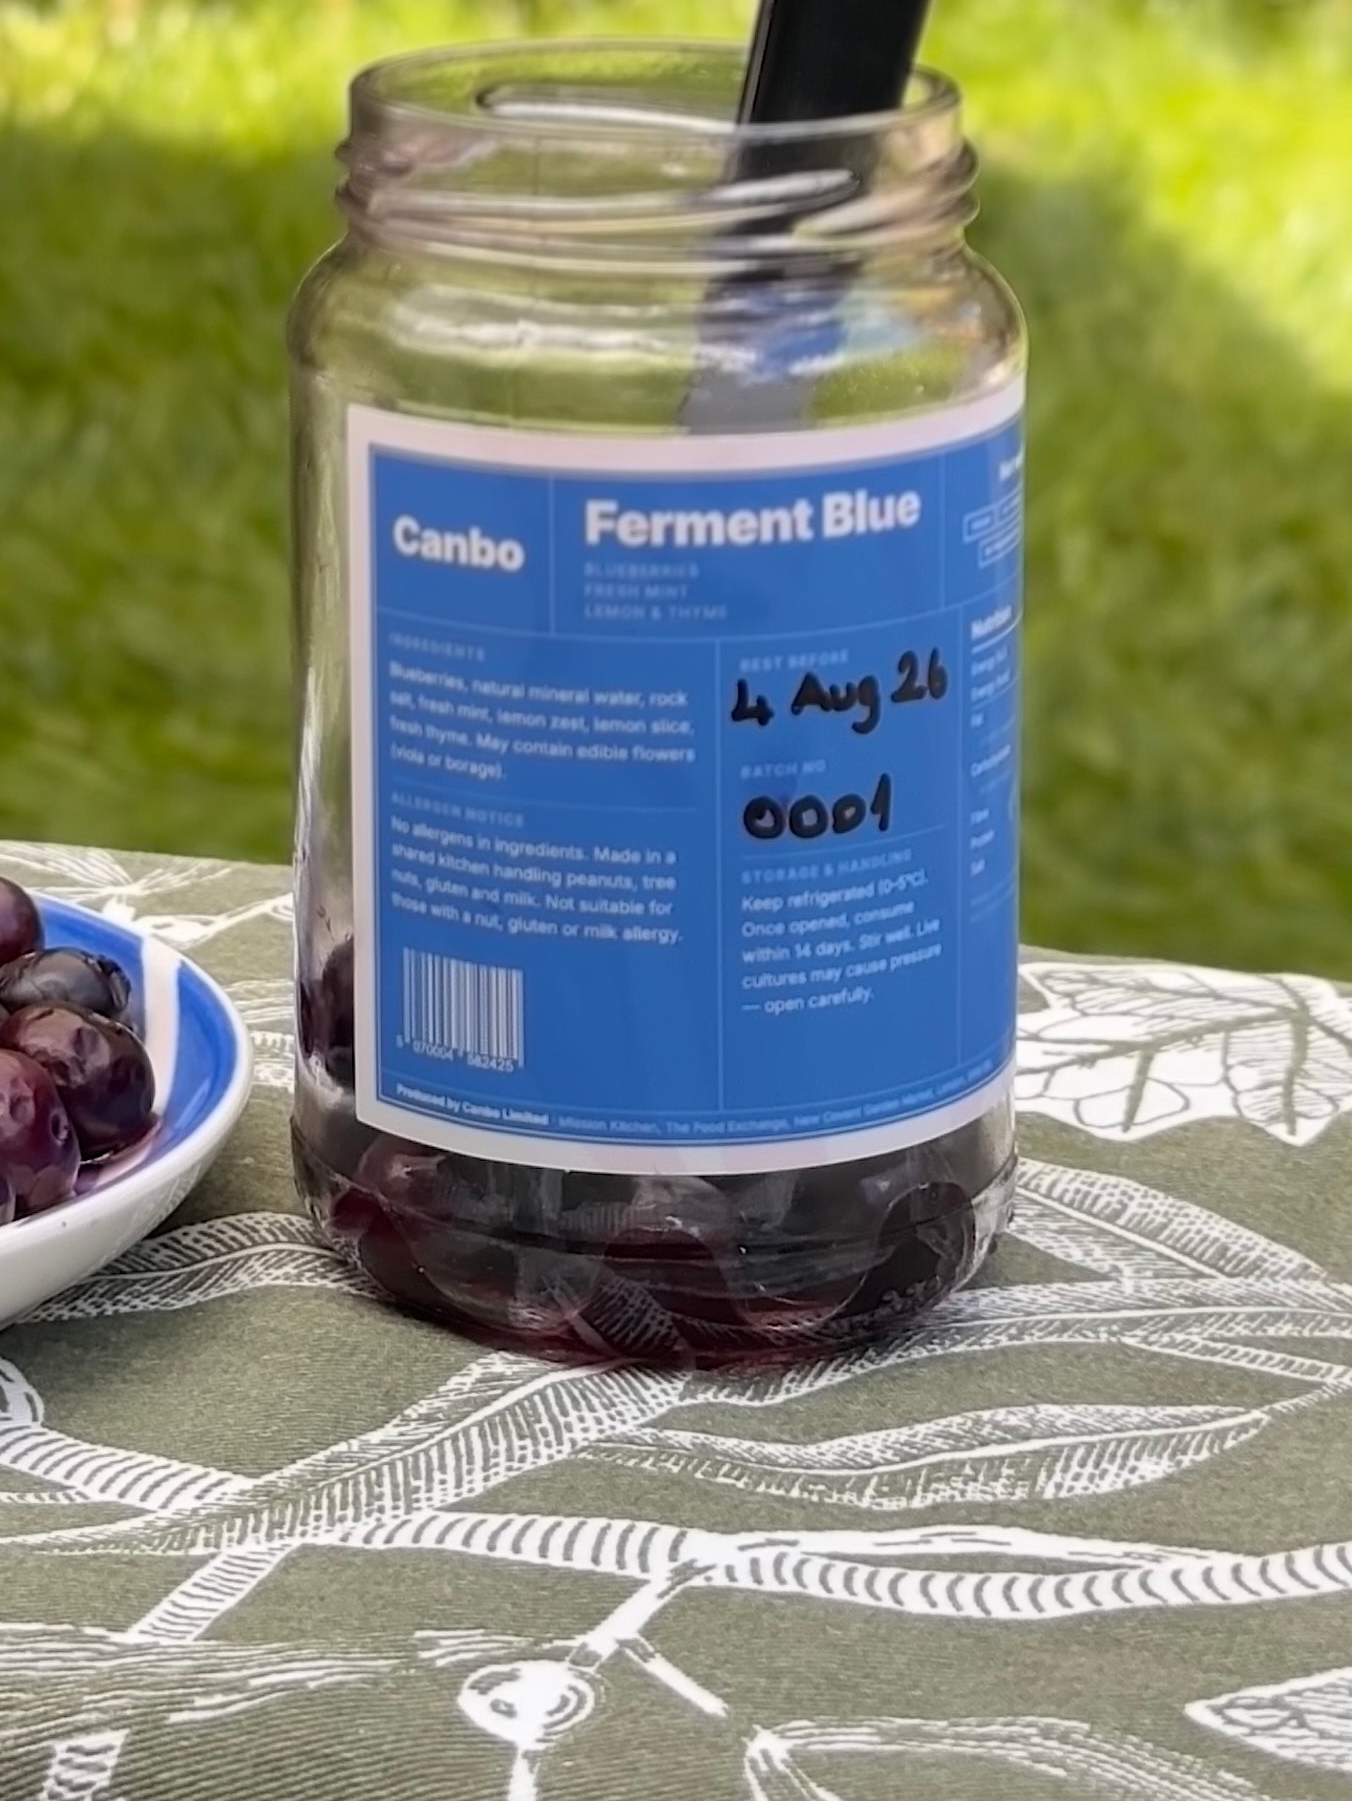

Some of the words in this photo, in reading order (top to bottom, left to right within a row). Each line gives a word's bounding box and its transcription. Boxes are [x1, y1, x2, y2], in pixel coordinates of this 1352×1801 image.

[584, 497, 814, 547] Ferment
[822, 488, 922, 538] Blue
[393, 514, 525, 572] Canbo
[584, 561, 699, 578] BLUEBERRIES
[584, 583, 638, 598] FRESH
[644, 584, 688, 599] MINT
[584, 605, 645, 619] LEMON
[651, 604, 661, 620] &
[668, 605, 727, 619] THYME
[740, 657, 782, 673] BEST
[788, 649, 849, 670] BEFORE
[389, 660, 469, 694] Blueberries,
[472, 680, 526, 698] natural
[528, 684, 590, 704] mineral
[594, 689, 645, 709] water,
[650, 689, 689, 706] rock
[731, 677, 774, 726] 4
[790, 671, 881, 735] Aug
[890, 646, 947, 703] 26
[418, 694, 455, 714] fresh
[457, 703, 493, 724] mint,
[496, 709, 546, 728] lemon
[550, 714, 589, 734] zest,
[593, 716, 646, 733] lemon
[651, 718, 695, 736] slice,
[476, 732, 510, 755] May
[512, 739, 573, 757] contain
[576, 743, 628, 760] edible
[632, 744, 696, 762] flowers
[427, 753, 442, 767] or
[445, 755, 508, 780] borage).
[740, 762, 798, 779] BATCH
[802, 759, 827, 774] NO
[464, 806, 525, 828] NOTICE
[743, 772, 891, 839] 0001
[391, 814, 410, 834] No
[412, 822, 474, 848] allergens
[477, 834, 491, 850] in
[495, 837, 590, 861] ingredients.
[593, 846, 642, 864] Made
[646, 848, 662, 865] in
[665, 851, 677, 865] a
[391, 843, 436, 865] shared
[438, 853, 490, 876] kitchen
[493, 863, 562, 888] handling
[566, 872, 638, 892] peanuts,
[642, 874, 677, 890] tree
[741, 864, 819, 884] STORAGE
[837, 848, 912, 875] HANDLING
[425, 875, 469, 897] gluten
[471, 887, 500, 903] and
[503, 891, 541, 907] milk.
[545, 893, 575, 910] Not
[579, 898, 645, 915] suitable
[649, 899, 673, 915] for
[741, 896, 784, 913] Keep
[787, 882, 875, 909] refrigerated
[430, 903, 460, 921] with
[474, 913, 504, 933] nut,
[507, 916, 558, 935] gluten
[562, 923, 580, 937] or
[622, 925, 684, 946] allergy.
[741, 921, 785, 938] Once
[789, 912, 850, 934] opened,
[854, 900, 915, 925] consume
[741, 944, 790, 963] within
[794, 942, 812, 958] 14
[815, 939, 855, 958] days.
[859, 932, 884, 950] Stir
[884, 924, 915, 945] well.
[916, 918, 941, 939] Live
[741, 970, 807, 989] cultures
[810, 967, 843, 982] may
[845, 958, 888, 978] cause
[890, 943, 942, 972] pressure
[764, 997, 804, 1016] open
[807, 985, 875, 1009] carefully.
[447, 1096, 462, 1113] by
[462, 1101, 500, 1119] Canbo
[502, 1108, 549, 1125] Limited
